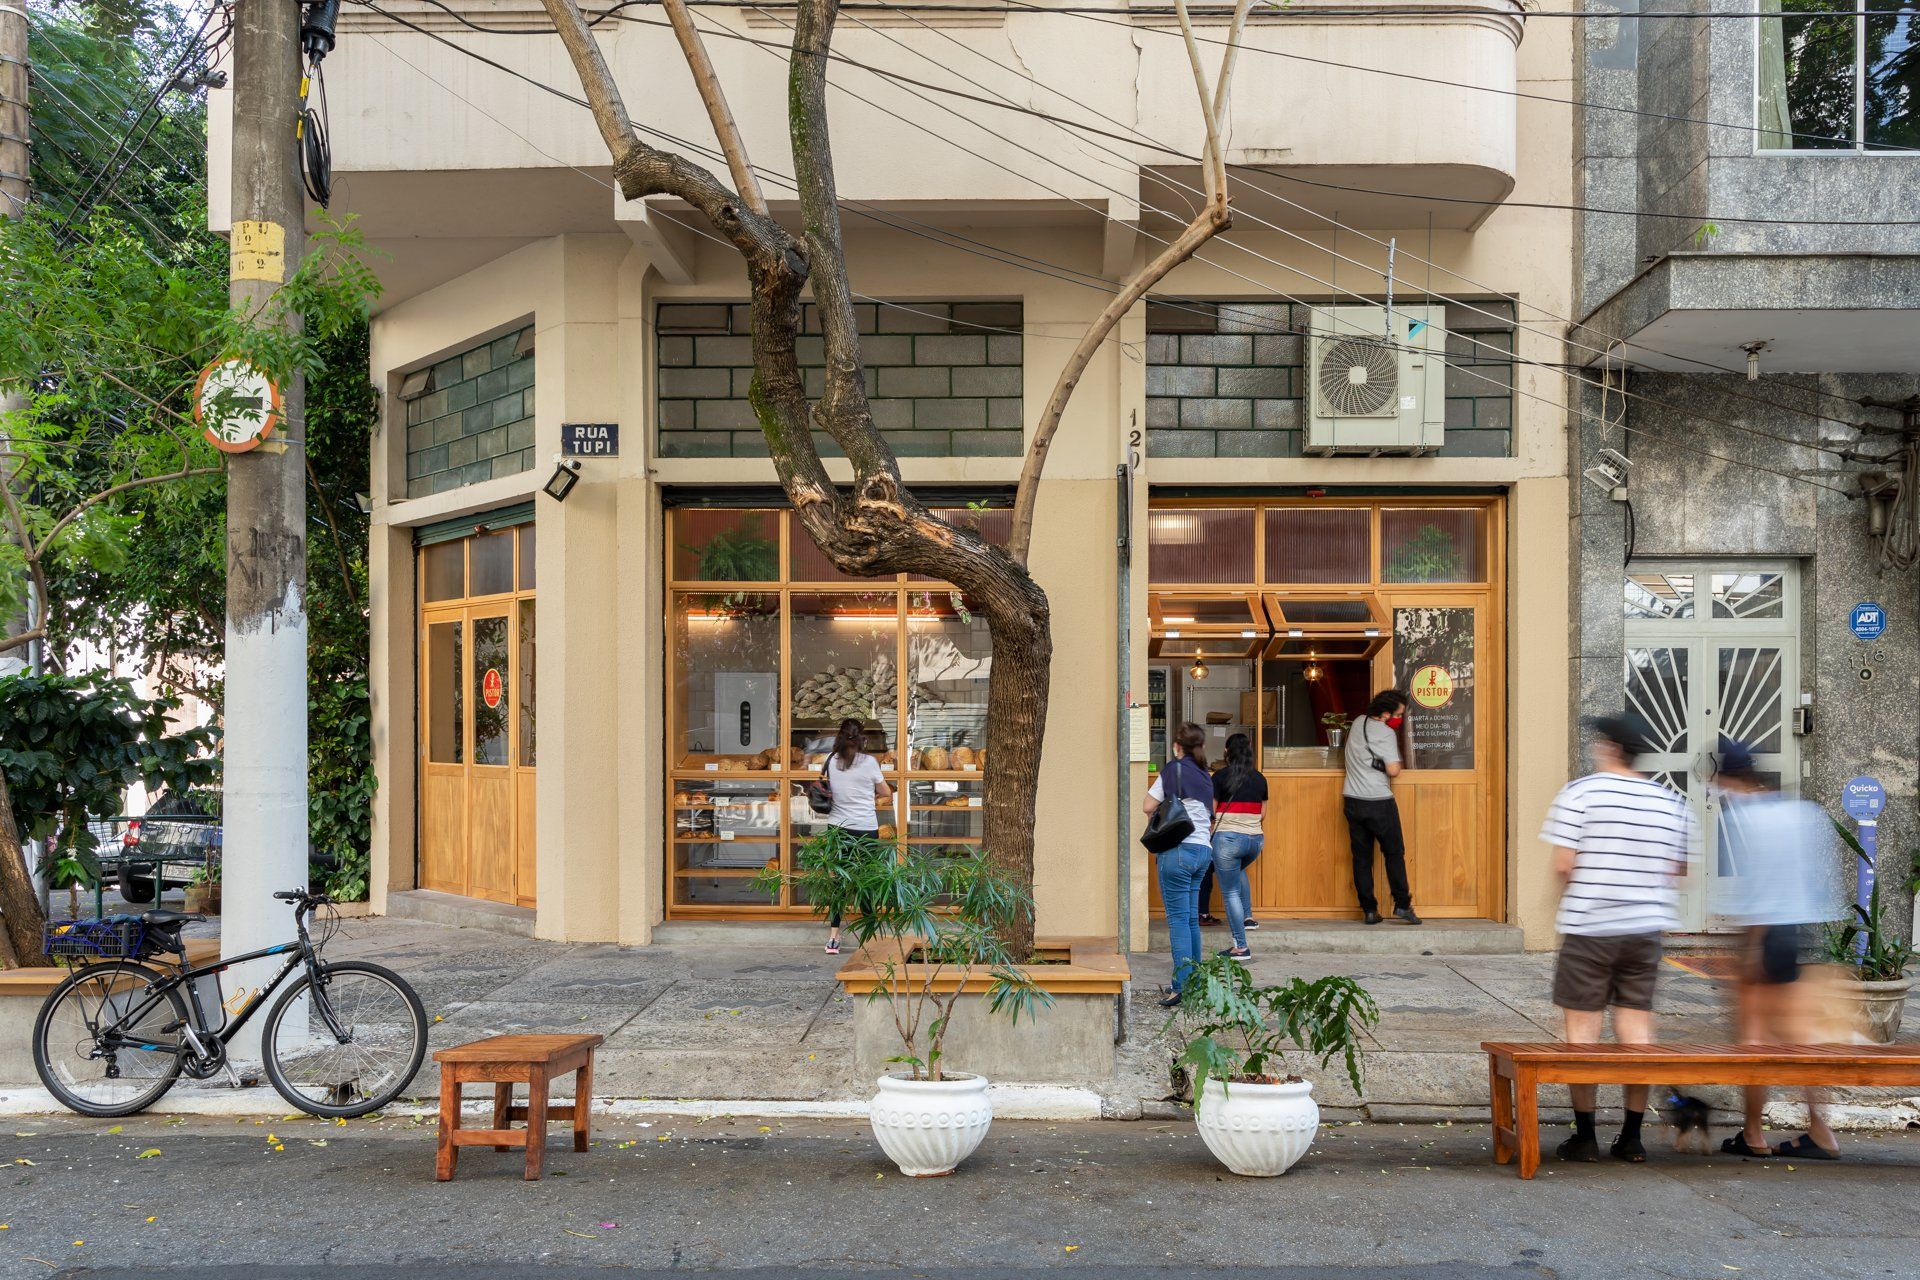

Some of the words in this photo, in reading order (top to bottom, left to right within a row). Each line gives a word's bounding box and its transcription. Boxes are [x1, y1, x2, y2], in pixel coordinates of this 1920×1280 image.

[575, 427, 609, 439] RUA
[572, 441, 611, 453] TUPI
[1857, 612, 1878, 623] ADT
[1849, 650, 1885, 669] 118
[1417, 687, 1449, 697] PISTOR
[1849, 784, 1879, 794] Quicko
[256, 950, 296, 996] TREK
